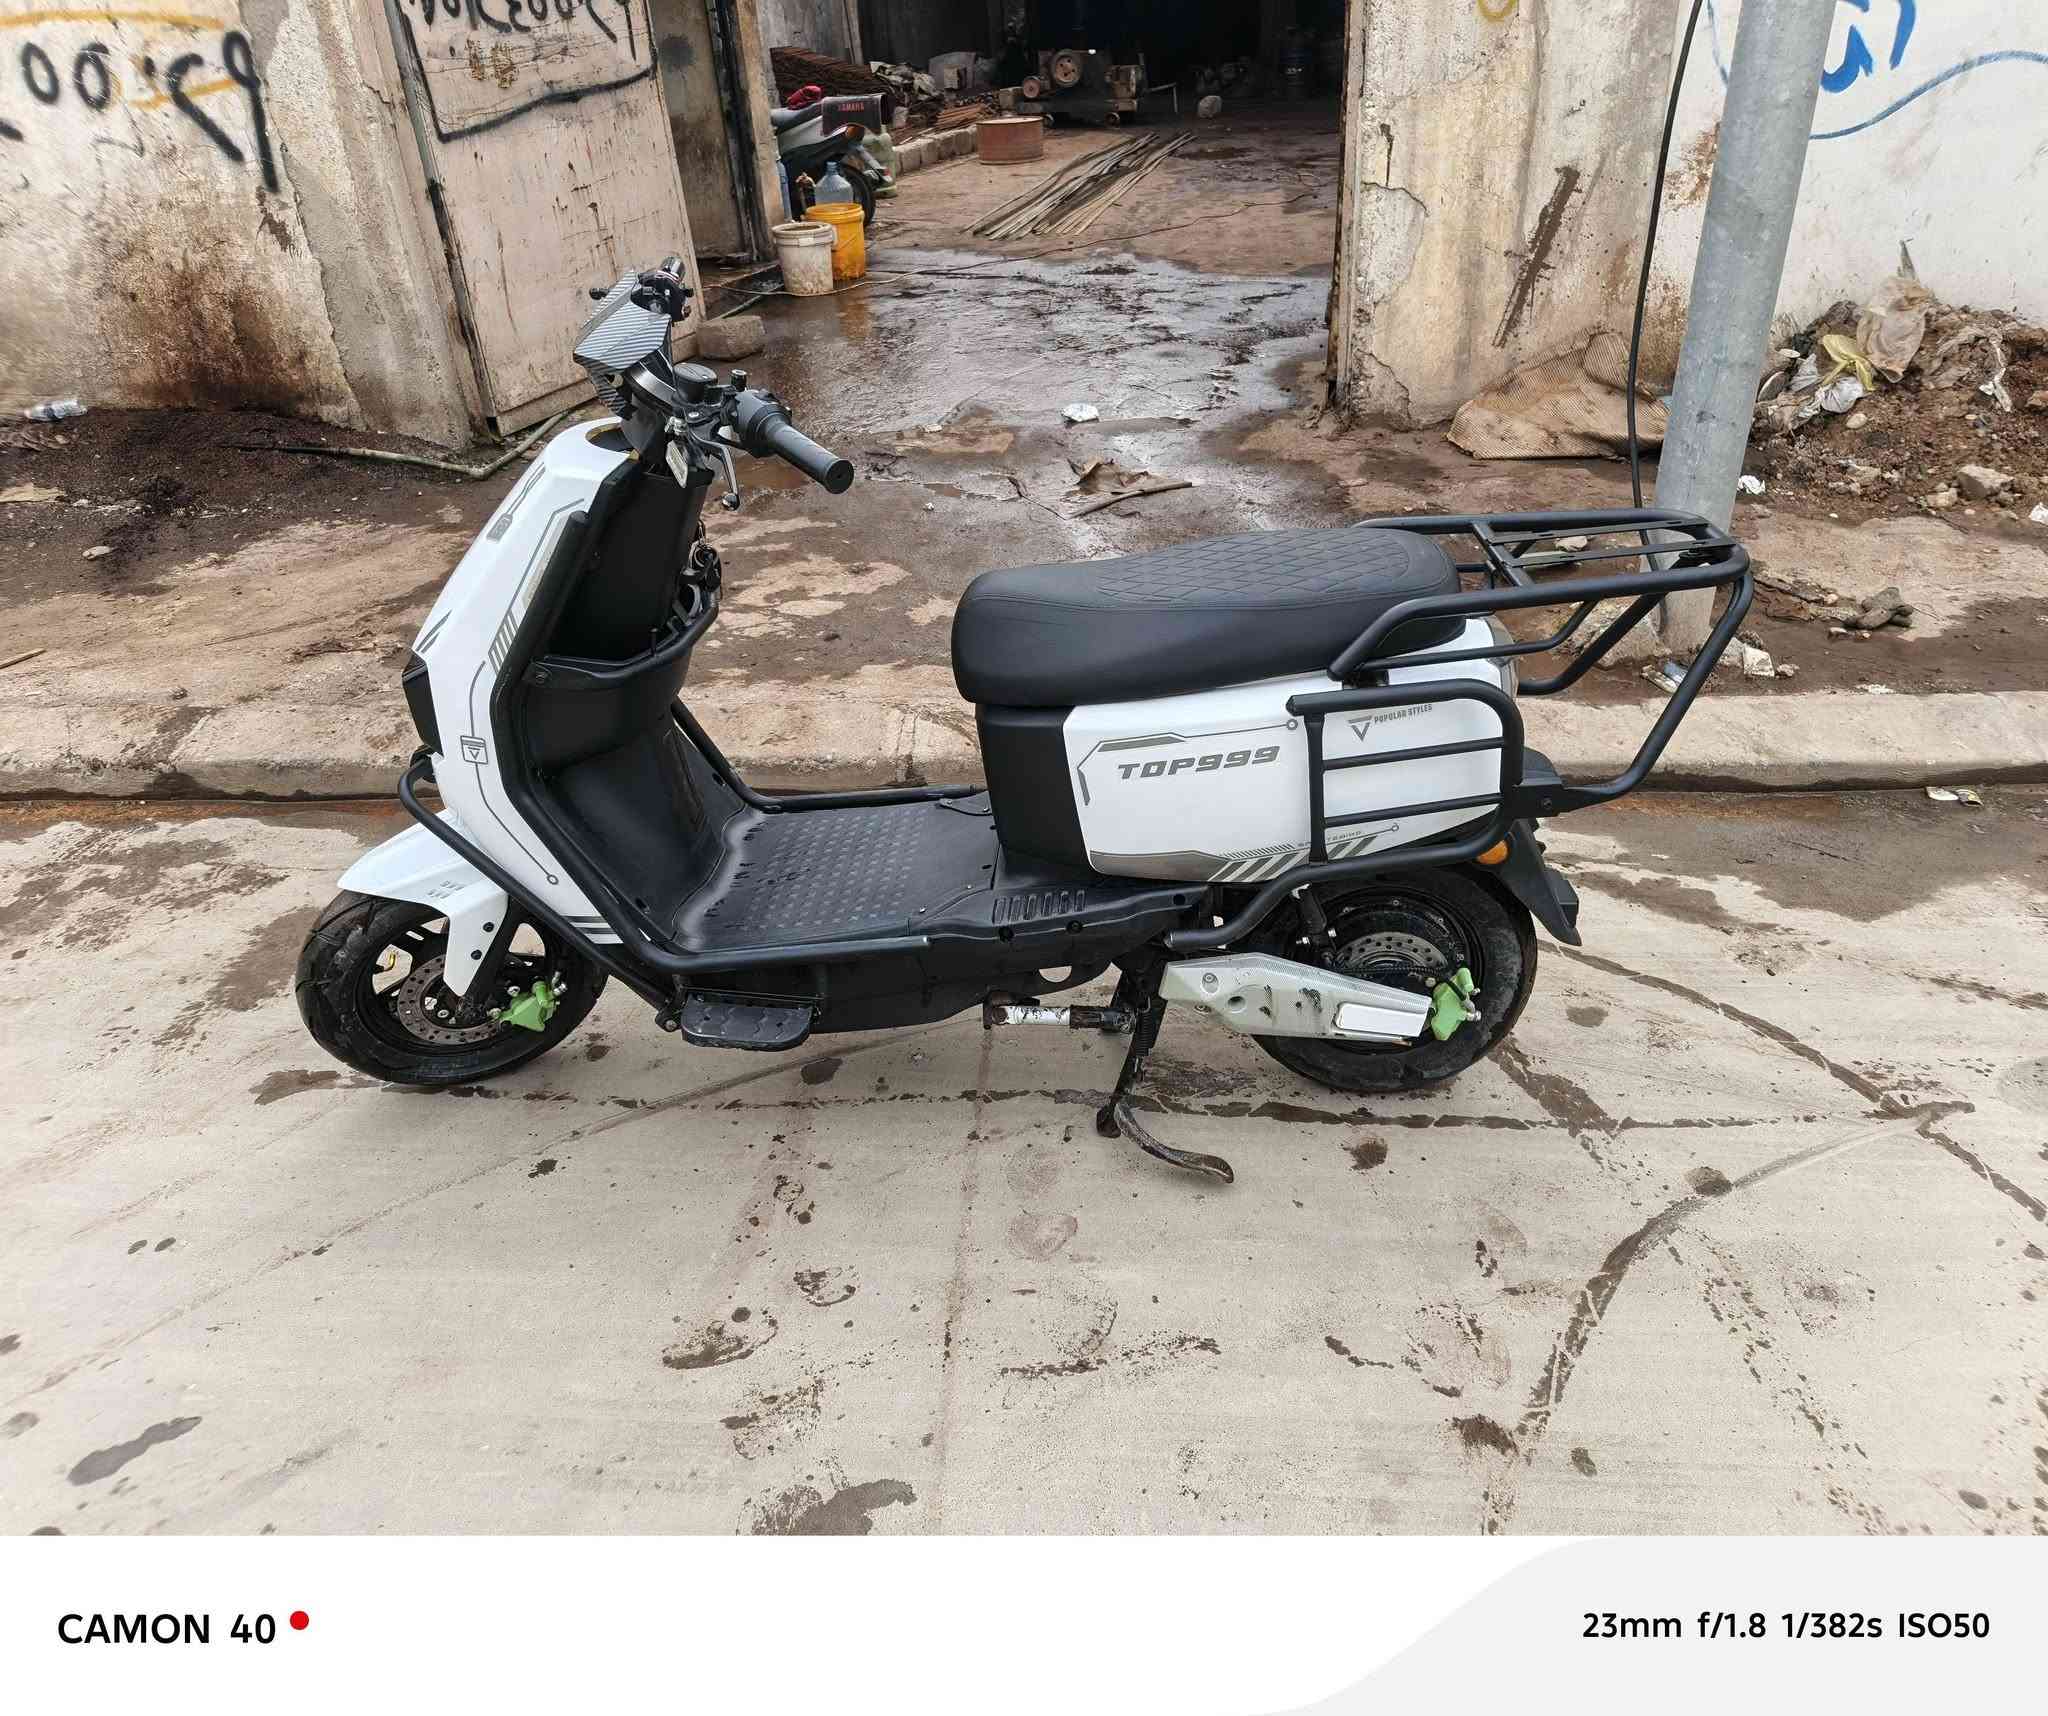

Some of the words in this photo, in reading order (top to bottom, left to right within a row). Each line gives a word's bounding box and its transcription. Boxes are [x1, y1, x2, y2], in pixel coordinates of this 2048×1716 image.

[1374, 709, 1407, 724] POPULAR
[1407, 703, 1433, 717] STYLES
[1118, 745, 1280, 780] TOP999
